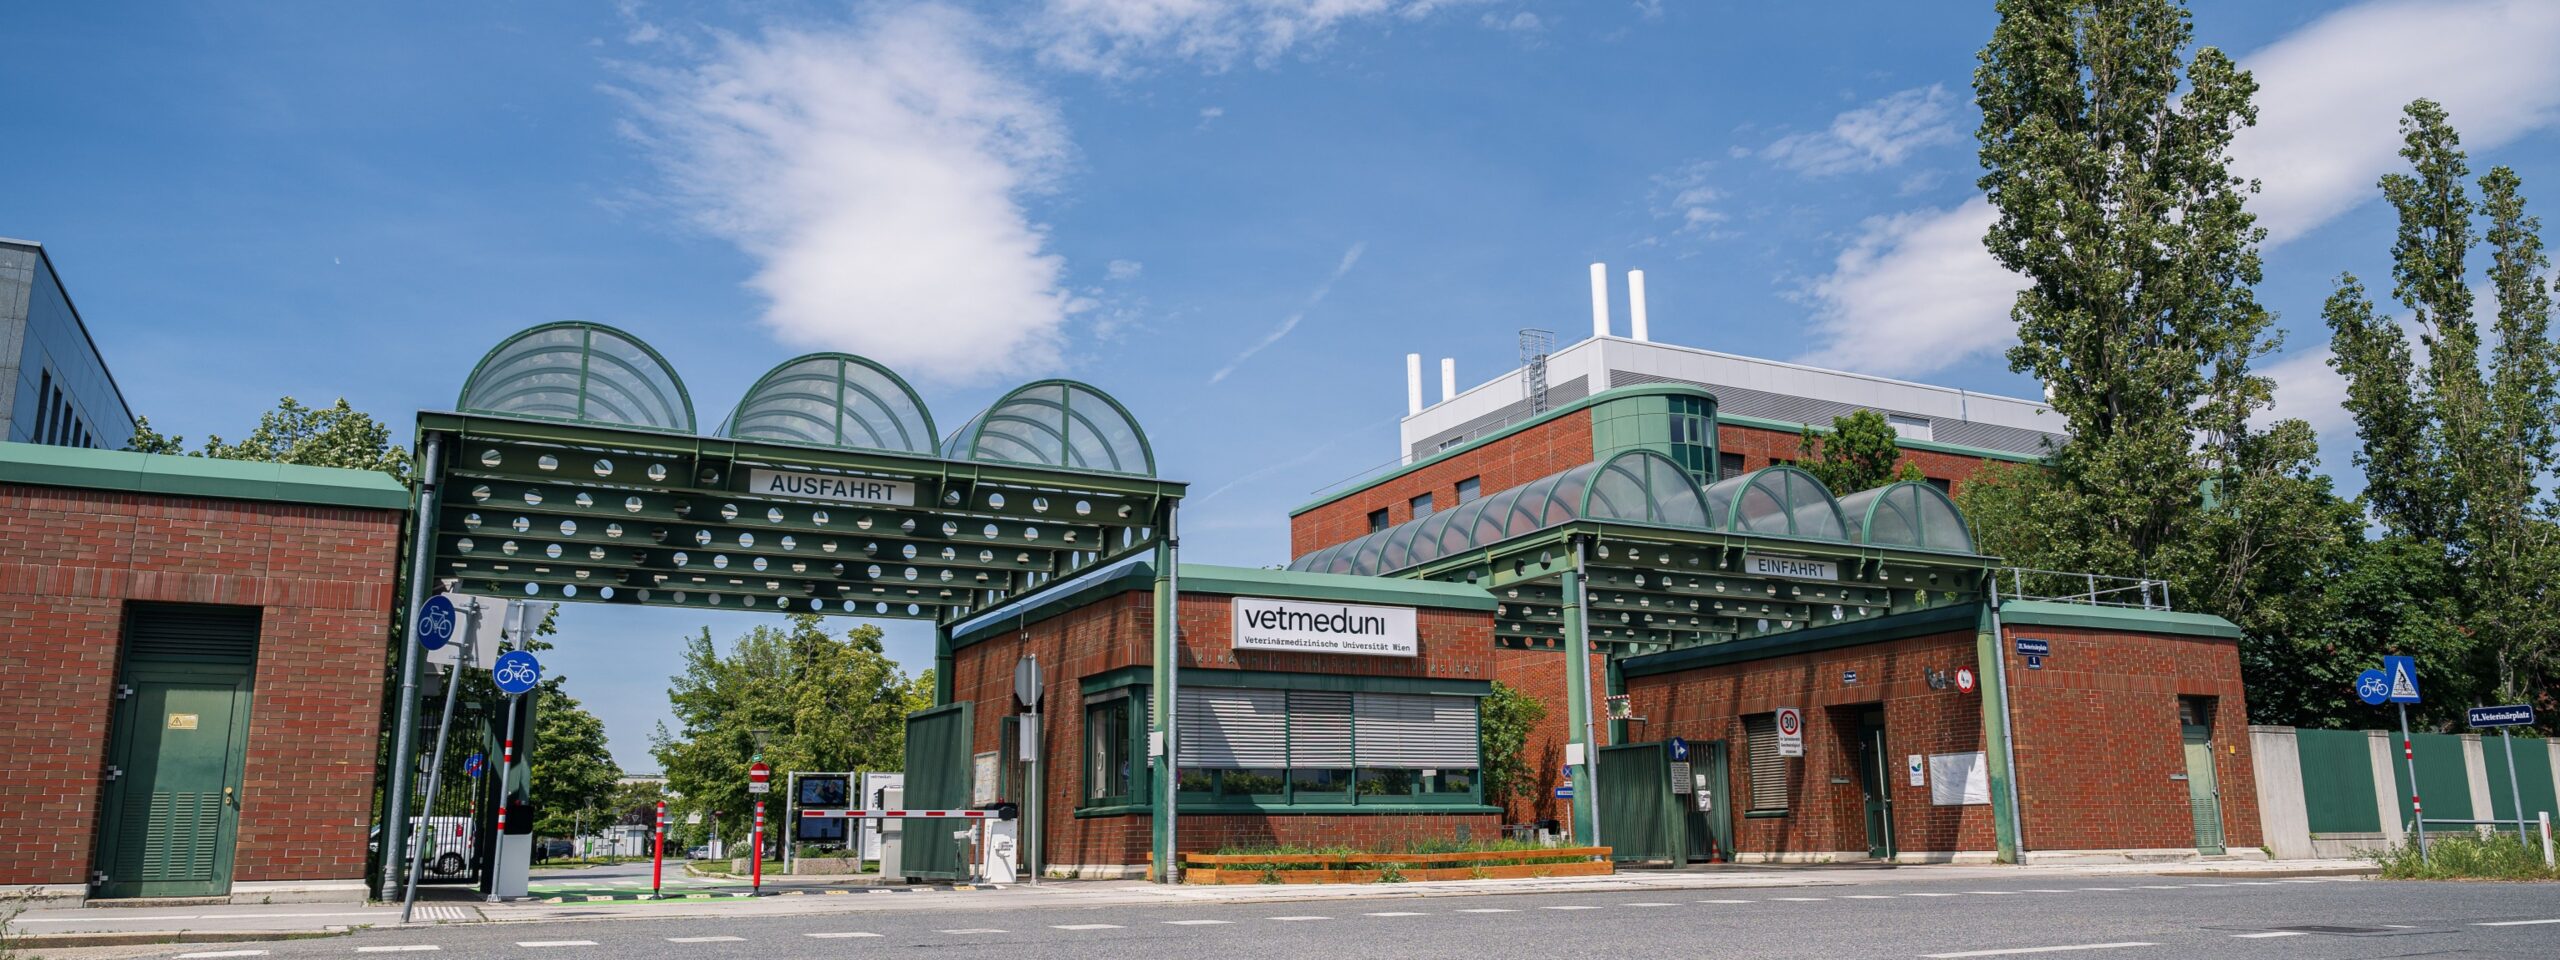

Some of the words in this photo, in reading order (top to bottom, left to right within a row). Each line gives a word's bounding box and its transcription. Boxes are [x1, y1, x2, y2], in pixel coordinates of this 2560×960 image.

[769, 474, 897, 501] AUSFAHRT
[1758, 558, 1825, 577] EINFAHRT
[1244, 636, 1339, 648] Veterinärmedizinische
[1342, 641, 1389, 651] Universität
[1392, 643, 1411, 652] Wien
[1784, 716, 1794, 729] 30
